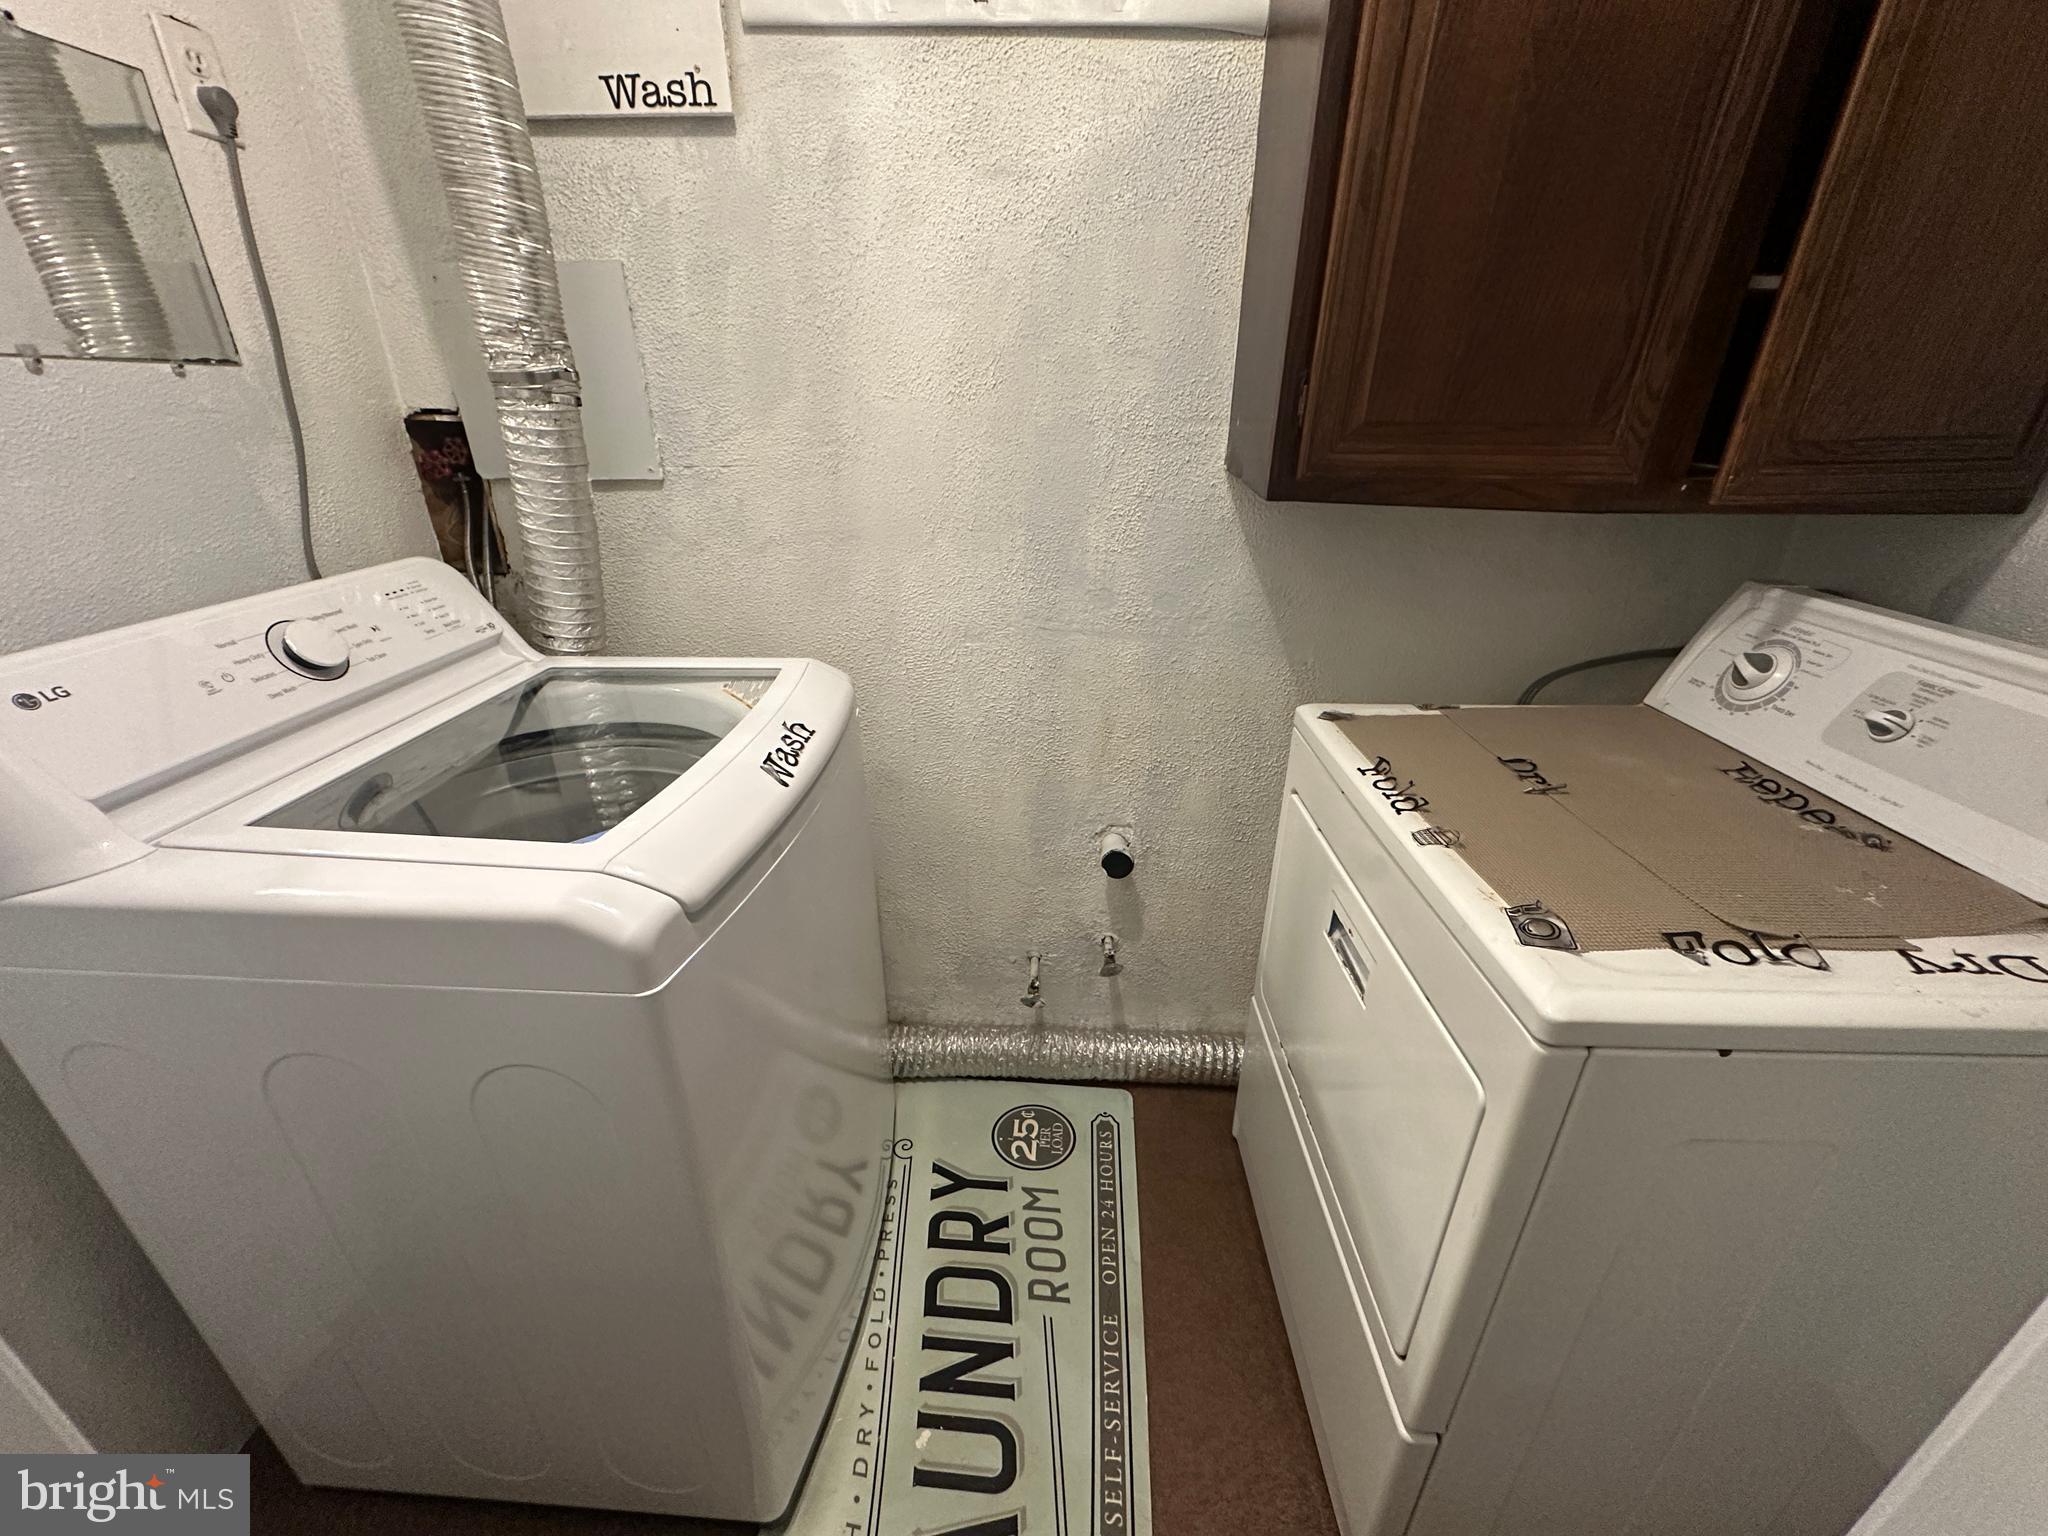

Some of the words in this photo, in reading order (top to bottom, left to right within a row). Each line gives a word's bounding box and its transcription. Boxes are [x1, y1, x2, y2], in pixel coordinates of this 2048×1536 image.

[598, 72, 717, 109] Wash
[38, 686, 71, 702] LG
[760, 721, 816, 787] Wash
[1039, 1127, 1052, 1148] PER
[1052, 1122, 1064, 1155] LOAD
[1100, 1131, 1114, 1191] HOURS
[1101, 1200, 1115, 1219] 24
[1021, 1186, 1071, 1304] ROOM
[1101, 1227, 1117, 1285] OPEN
[853, 1403, 874, 1478] DRY
[865, 1288, 886, 1371] FOLD
[877, 1179, 898, 1260] PRESS
[1103, 1314, 1123, 1527] SELF-SERVICE
